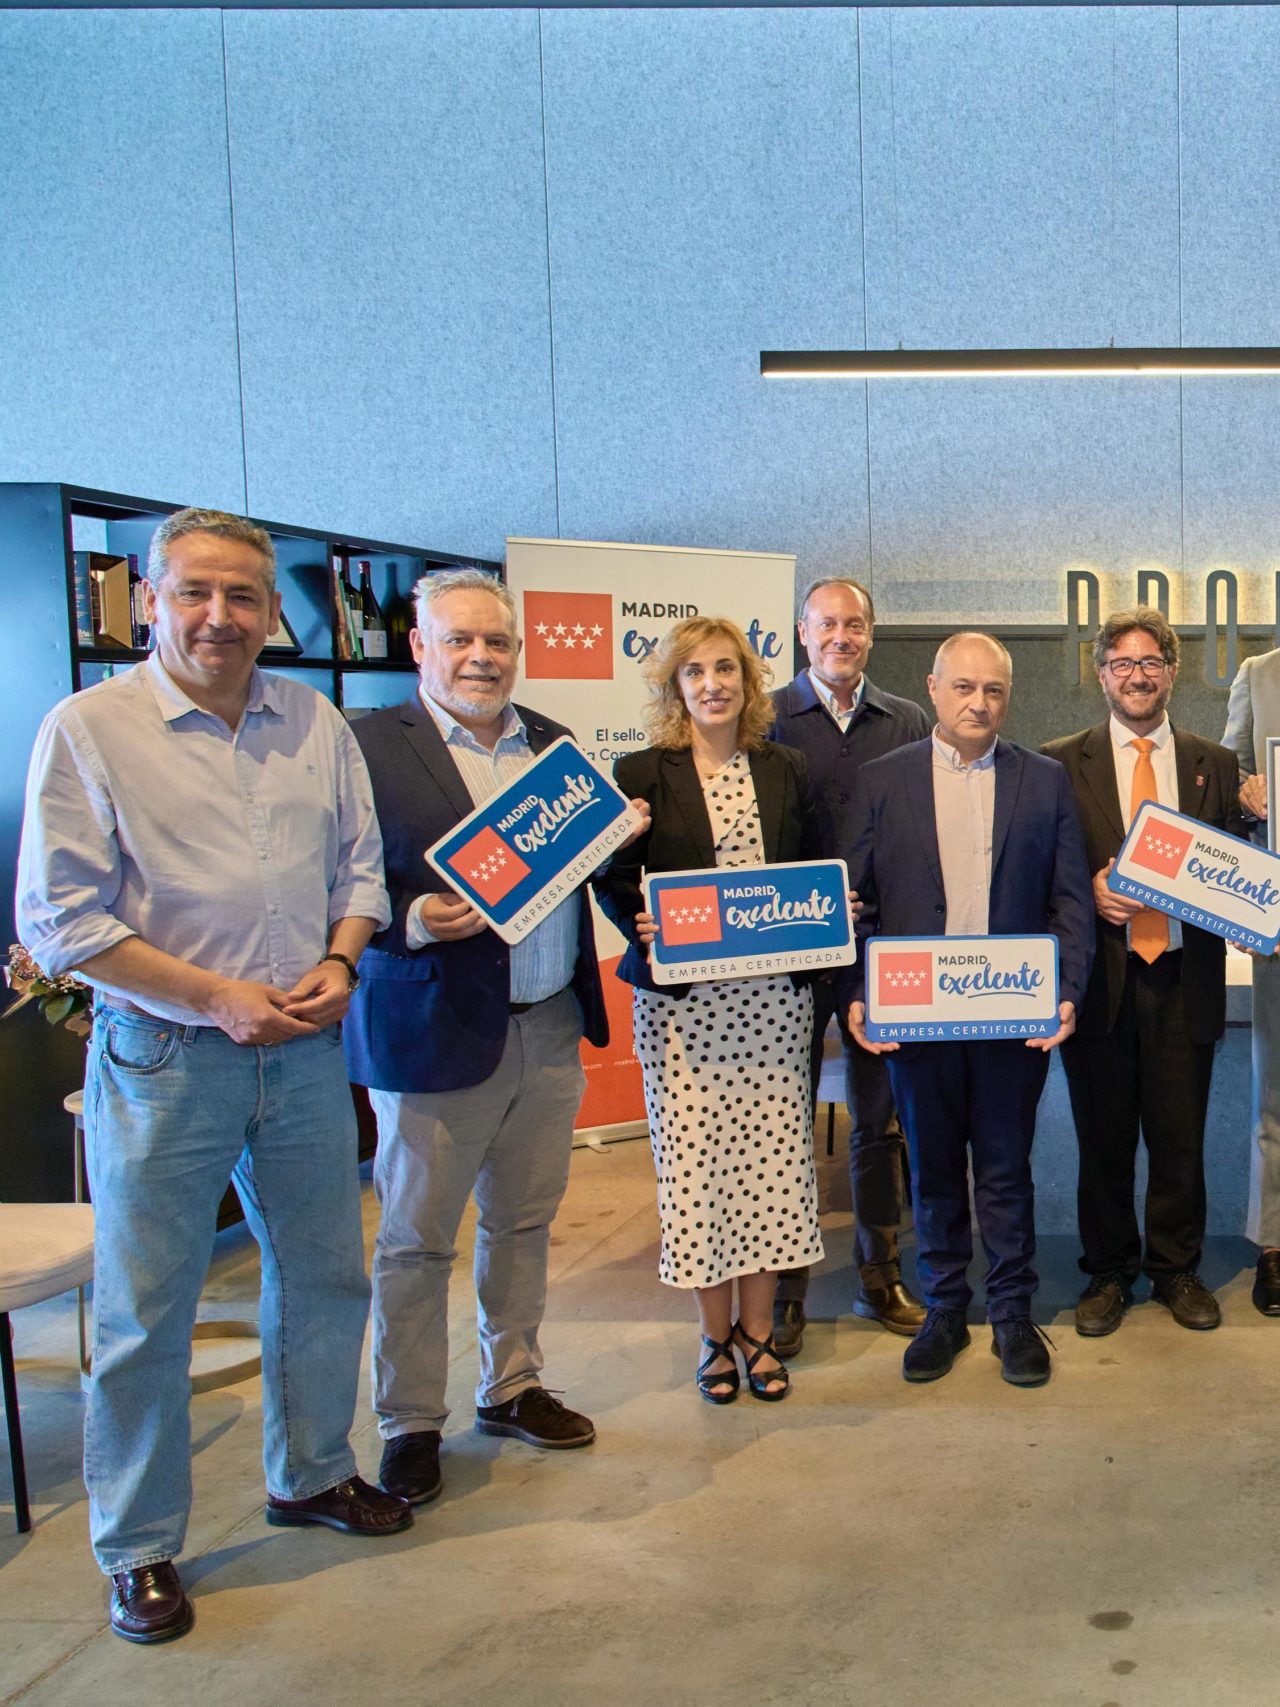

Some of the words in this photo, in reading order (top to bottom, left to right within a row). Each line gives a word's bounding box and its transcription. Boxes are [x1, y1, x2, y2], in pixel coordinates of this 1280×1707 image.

[622, 602, 699, 618] MADRID
[596, 728, 608, 741] El
[613, 728, 645, 741] sello
[497, 795, 539, 832] MADRID
[514, 774, 595, 853] excelente
[1195, 841, 1239, 866] MADRID
[514, 884, 564, 932] EMPRESA
[566, 818, 633, 882] CERTIFICADA
[1187, 857, 1280, 906] excelente
[723, 885, 776, 899] MADRID
[726, 889, 836, 929] excelente
[1119, 881, 1175, 910] EMPRESA
[1181, 907, 1263, 948] CERTIFICADA
[669, 964, 737, 979] EMPRESA
[746, 952, 842, 970] CERTIFICADA
[938, 955, 987, 966] MADRID
[938, 961, 1044, 995] excelente
[880, 1027, 945, 1037] EMPRESA
[952, 1024, 1046, 1035] CERTIFICADA
